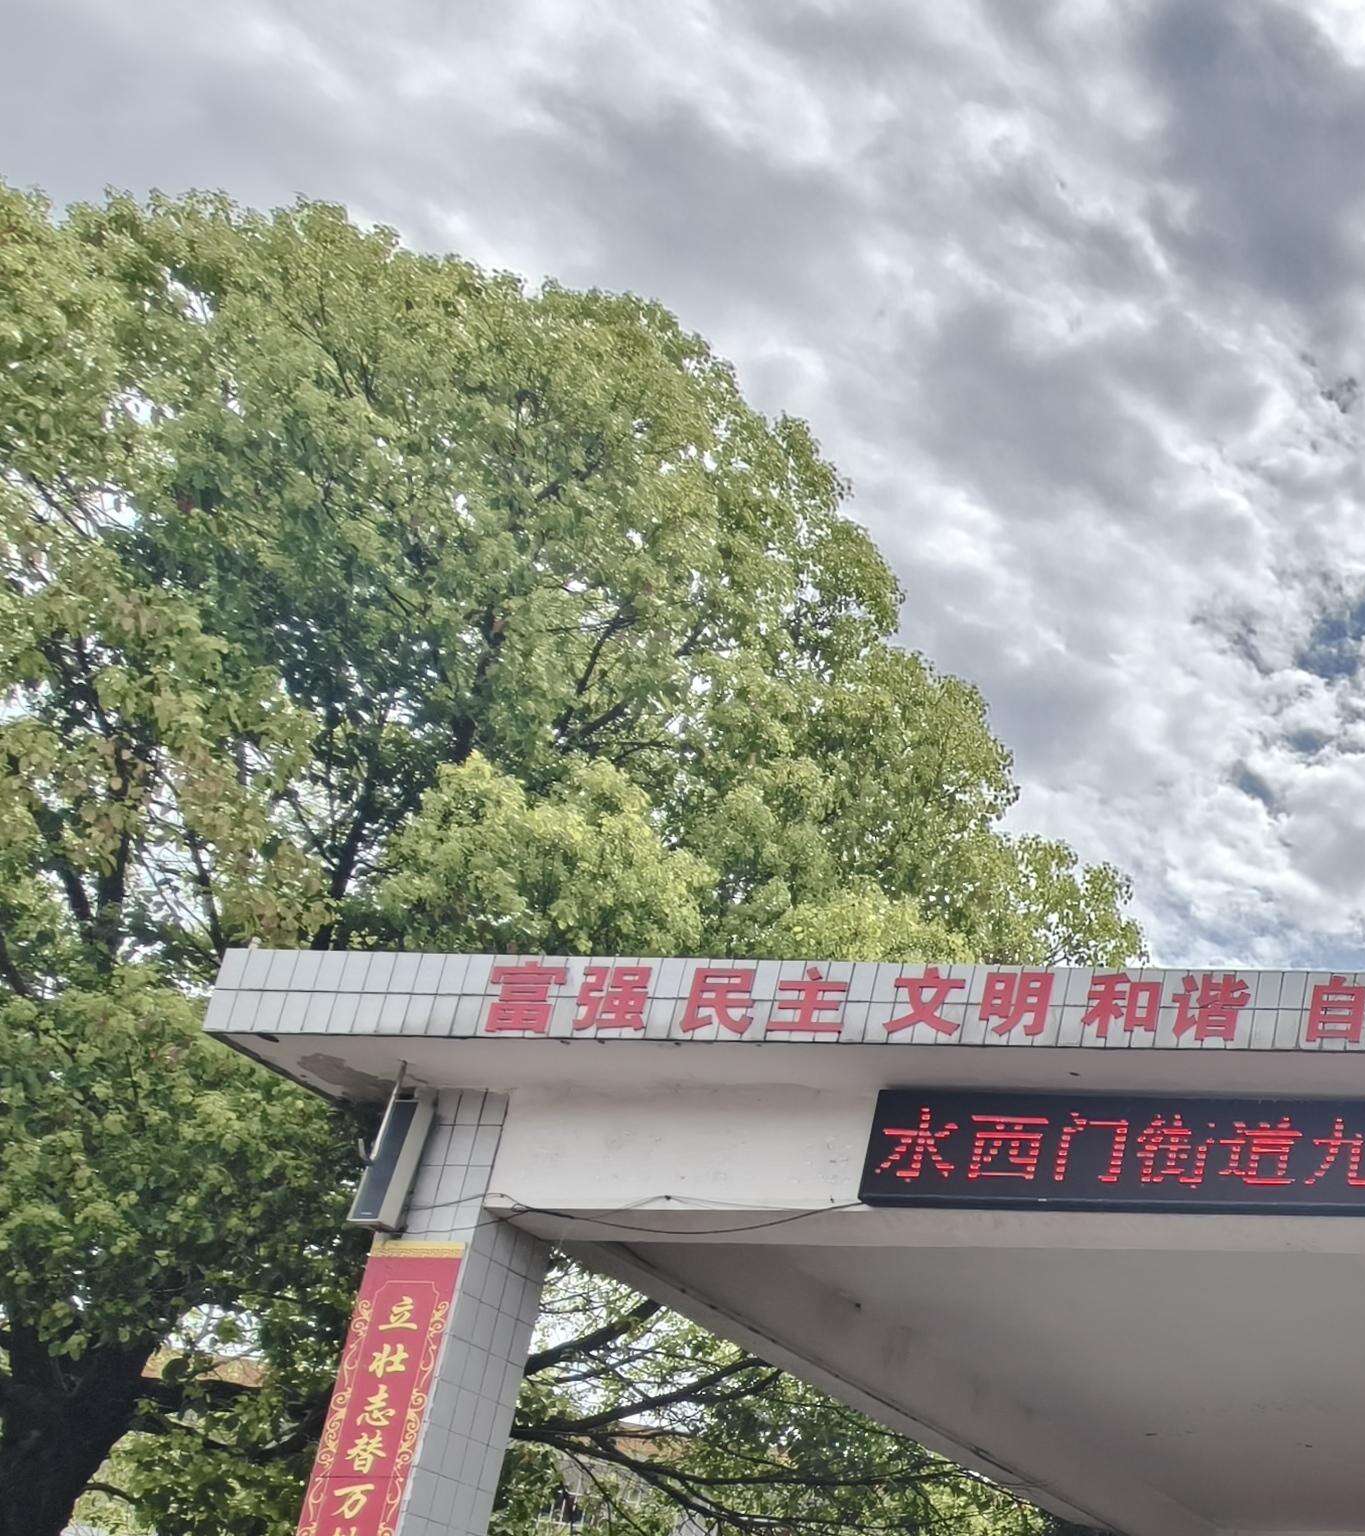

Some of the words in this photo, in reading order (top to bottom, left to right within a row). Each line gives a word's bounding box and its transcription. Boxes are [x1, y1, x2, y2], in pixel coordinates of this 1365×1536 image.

[488, 965, 649, 1031] 富强
[684, 968, 843, 1031] 民主
[888, 967, 1053, 1035] 文明
[1085, 974, 1247, 1041] 和谐
